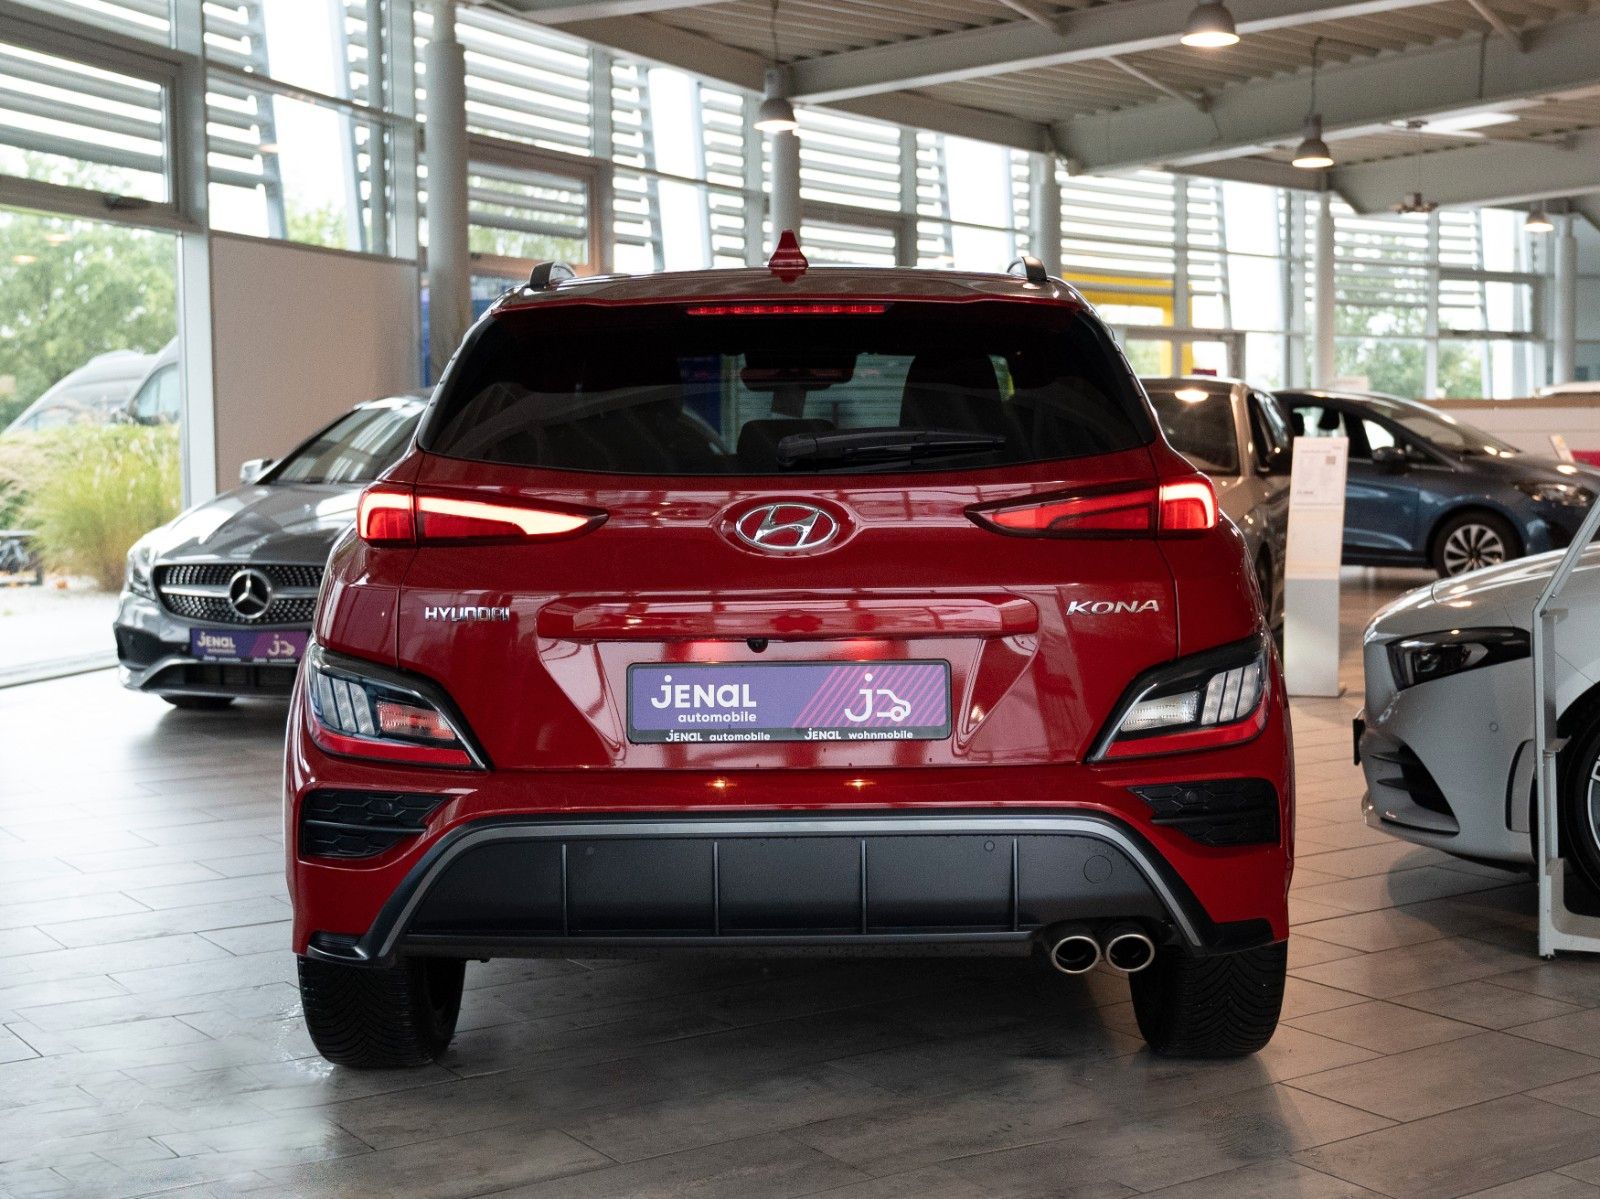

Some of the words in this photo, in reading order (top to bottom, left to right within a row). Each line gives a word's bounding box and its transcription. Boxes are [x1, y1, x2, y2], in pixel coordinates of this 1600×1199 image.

[1066, 600, 1160, 616] KONA
[424, 606, 510, 622] HYUNDAI
[678, 711, 757, 722] automobile
[709, 732, 771, 741] automobile
[848, 730, 913, 739] wohnmobile
